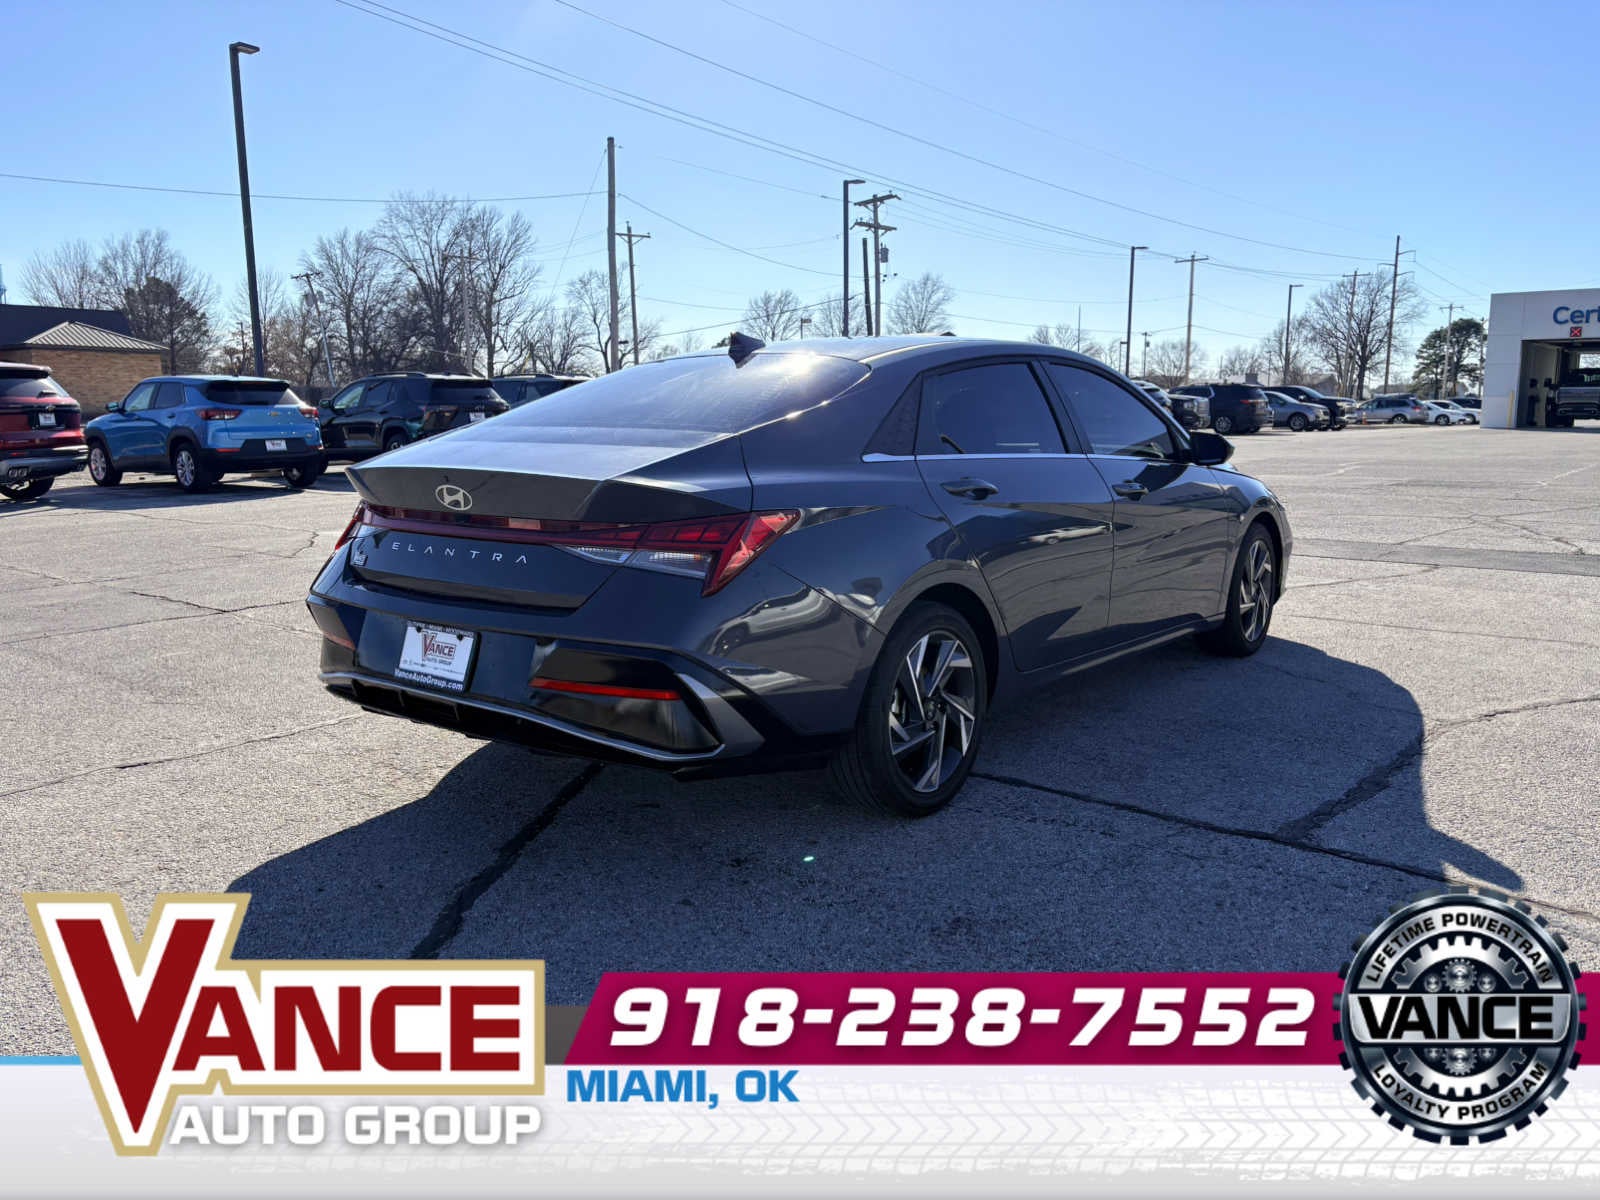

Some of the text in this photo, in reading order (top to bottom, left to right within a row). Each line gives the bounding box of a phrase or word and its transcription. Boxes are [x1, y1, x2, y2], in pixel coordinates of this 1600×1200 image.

[391, 541, 528, 565] ELANTRA
[423, 633, 455, 658] VANCE
[394, 667, 464, 691] VanceAutoGroup.com
